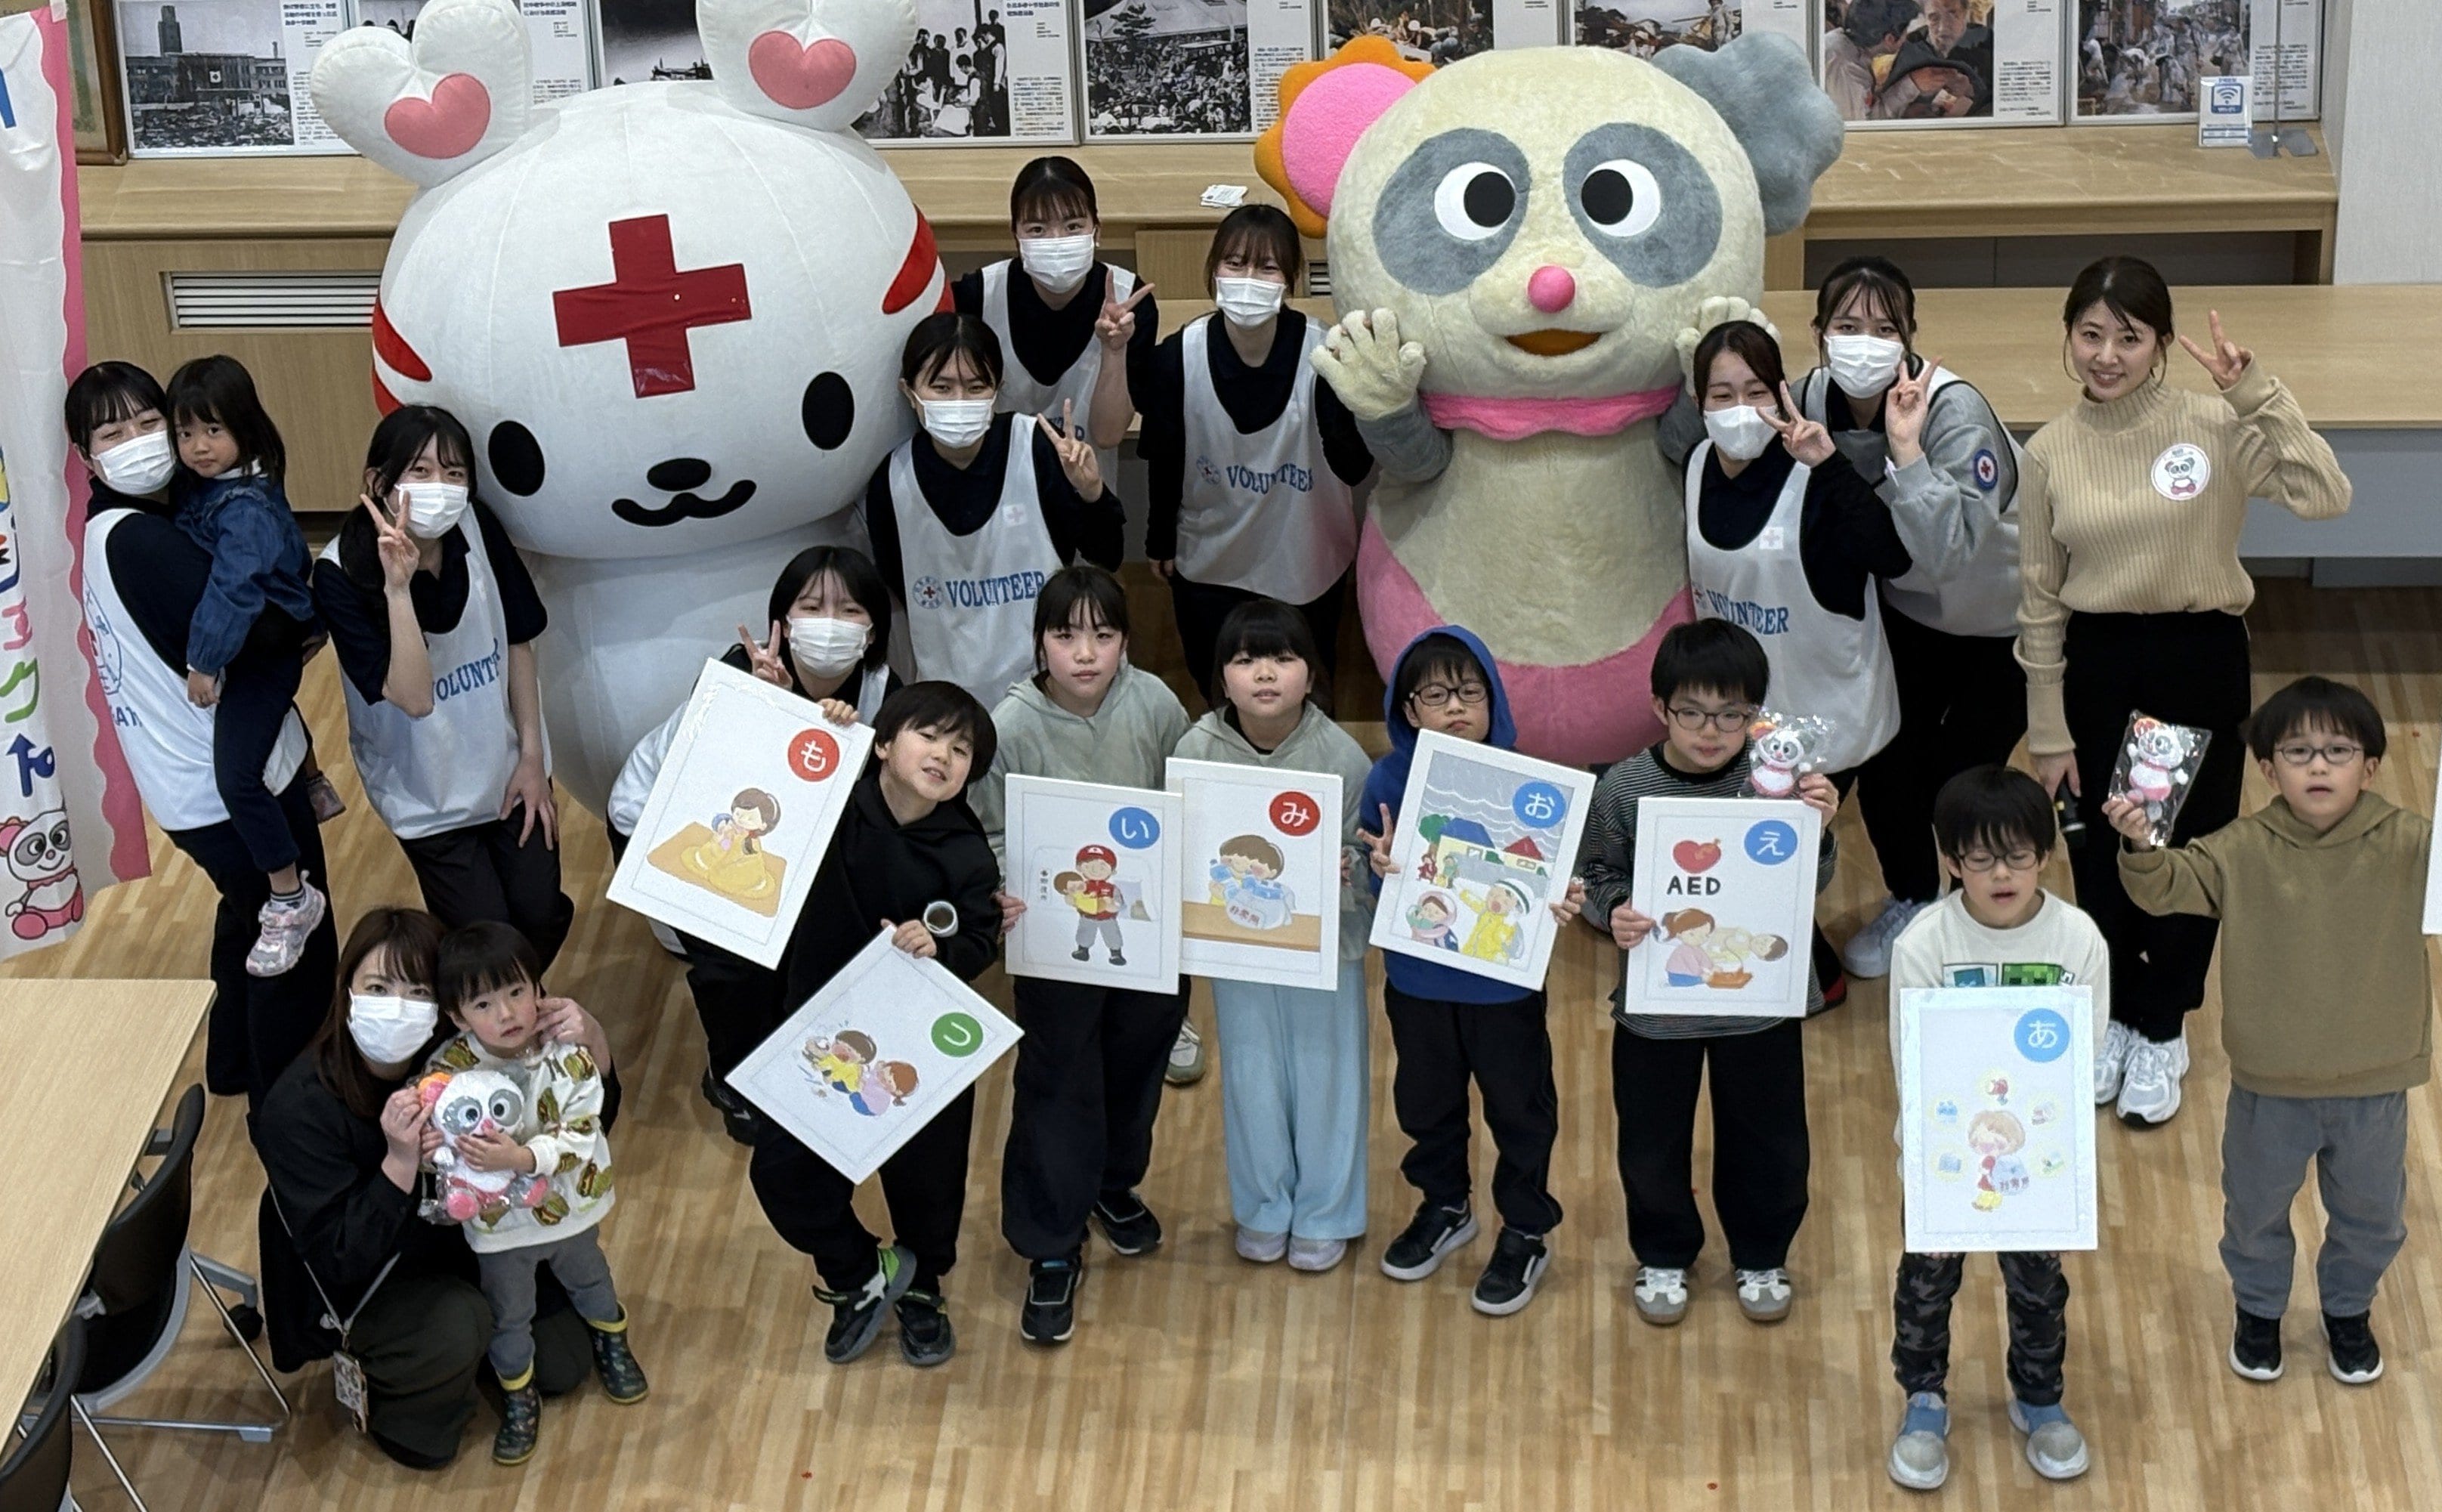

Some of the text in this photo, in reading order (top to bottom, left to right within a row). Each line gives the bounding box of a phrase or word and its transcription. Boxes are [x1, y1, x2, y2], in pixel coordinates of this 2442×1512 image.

[800, 740, 827, 772] も
[1281, 802, 1310, 827] み
[1525, 793, 1555, 819] お
[1121, 818, 1150, 839] い
[1756, 830, 1785, 856] え
[1666, 875, 1721, 896] AED
[942, 1021, 972, 1047] つ
[2027, 1020, 2058, 1049] あ
